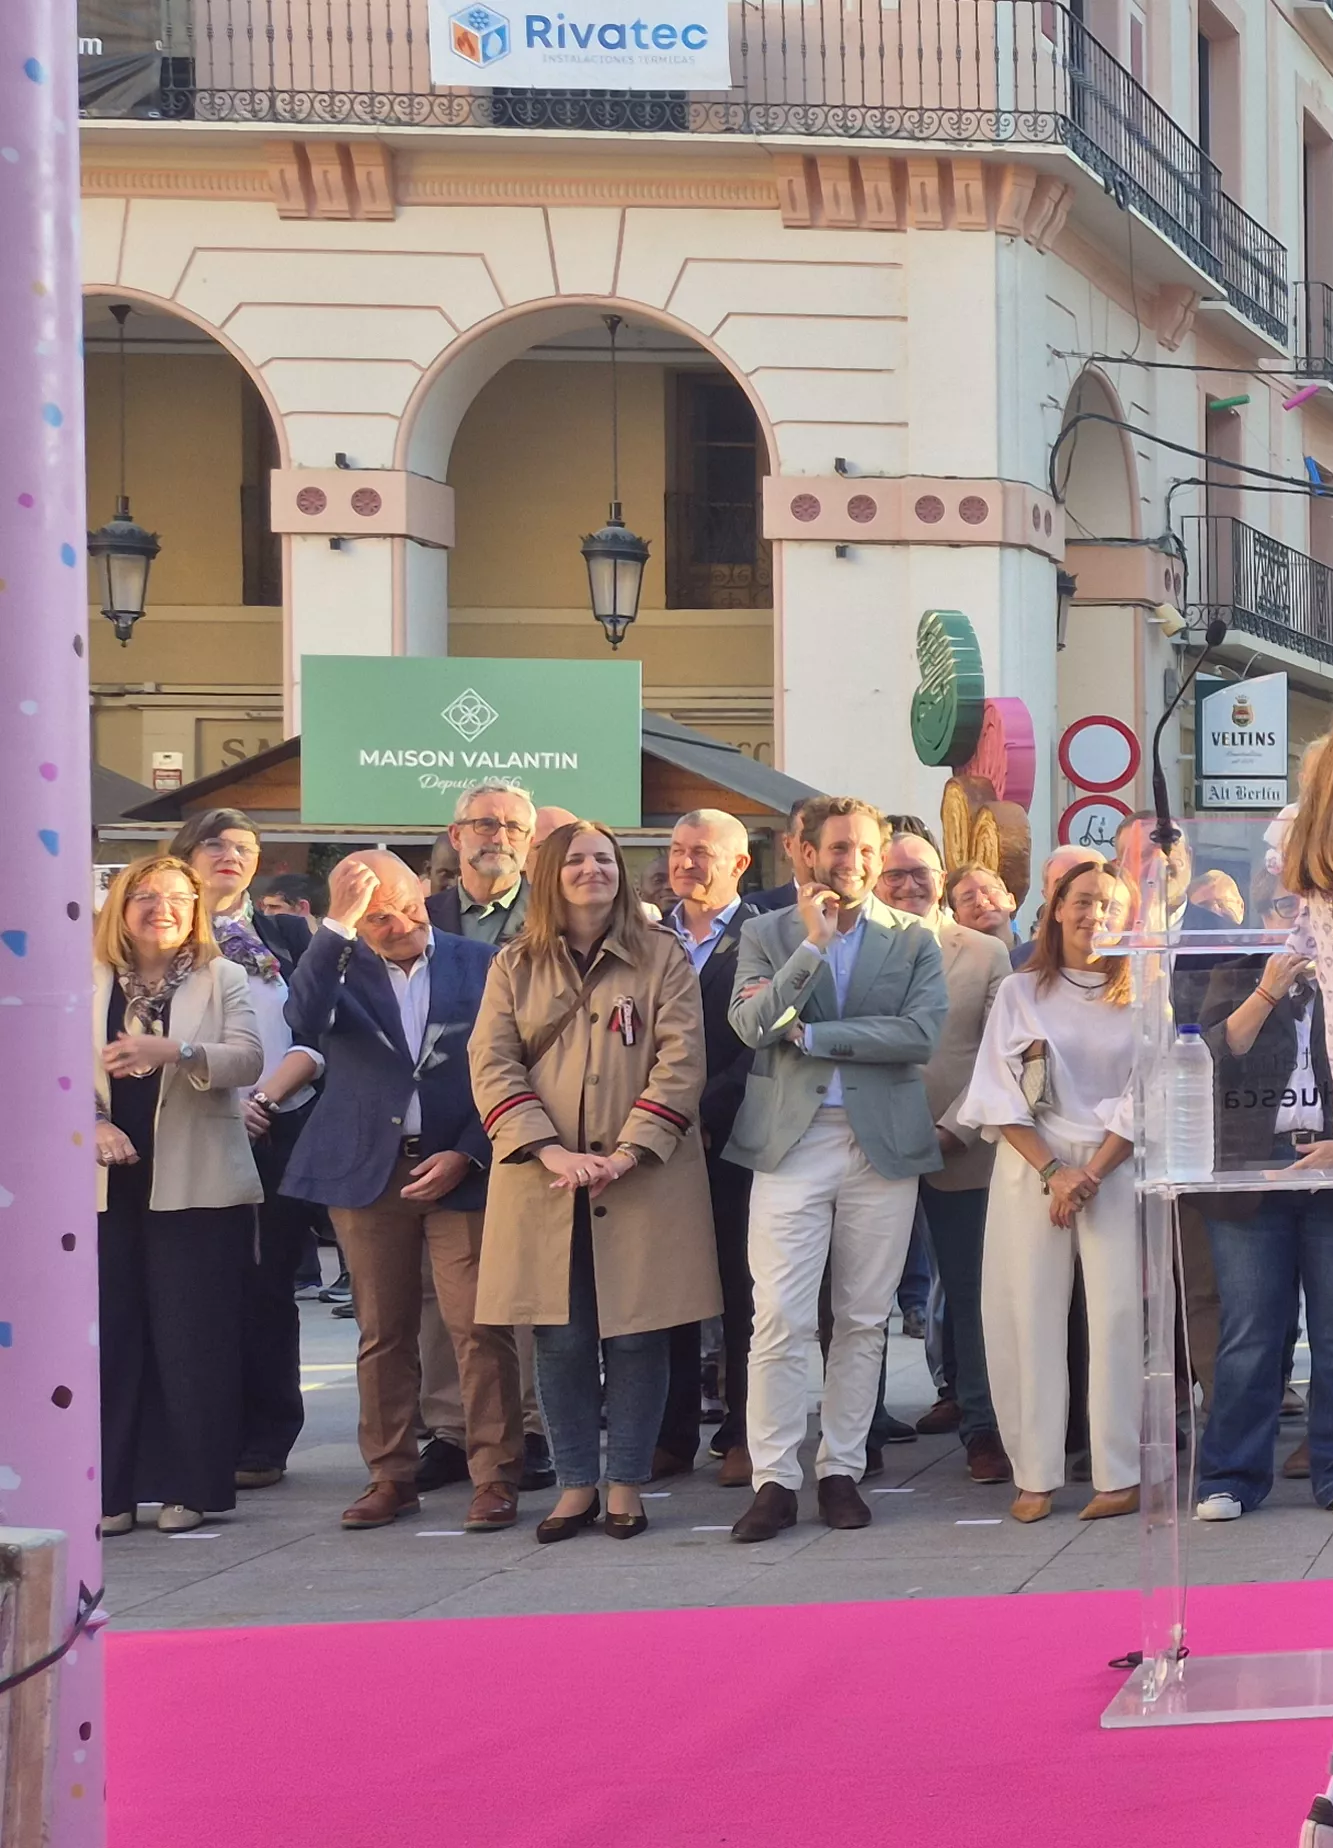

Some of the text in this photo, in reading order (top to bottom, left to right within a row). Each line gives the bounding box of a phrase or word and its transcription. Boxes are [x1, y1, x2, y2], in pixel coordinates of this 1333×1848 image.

[525, 12, 709, 50] Rivatec
[1211, 731, 1276, 747] VELTINS
[359, 749, 579, 770] MAISON VALANTIN
[418, 773, 477, 796] Depuis
[1208, 784, 1280, 802] Alt Berlin
